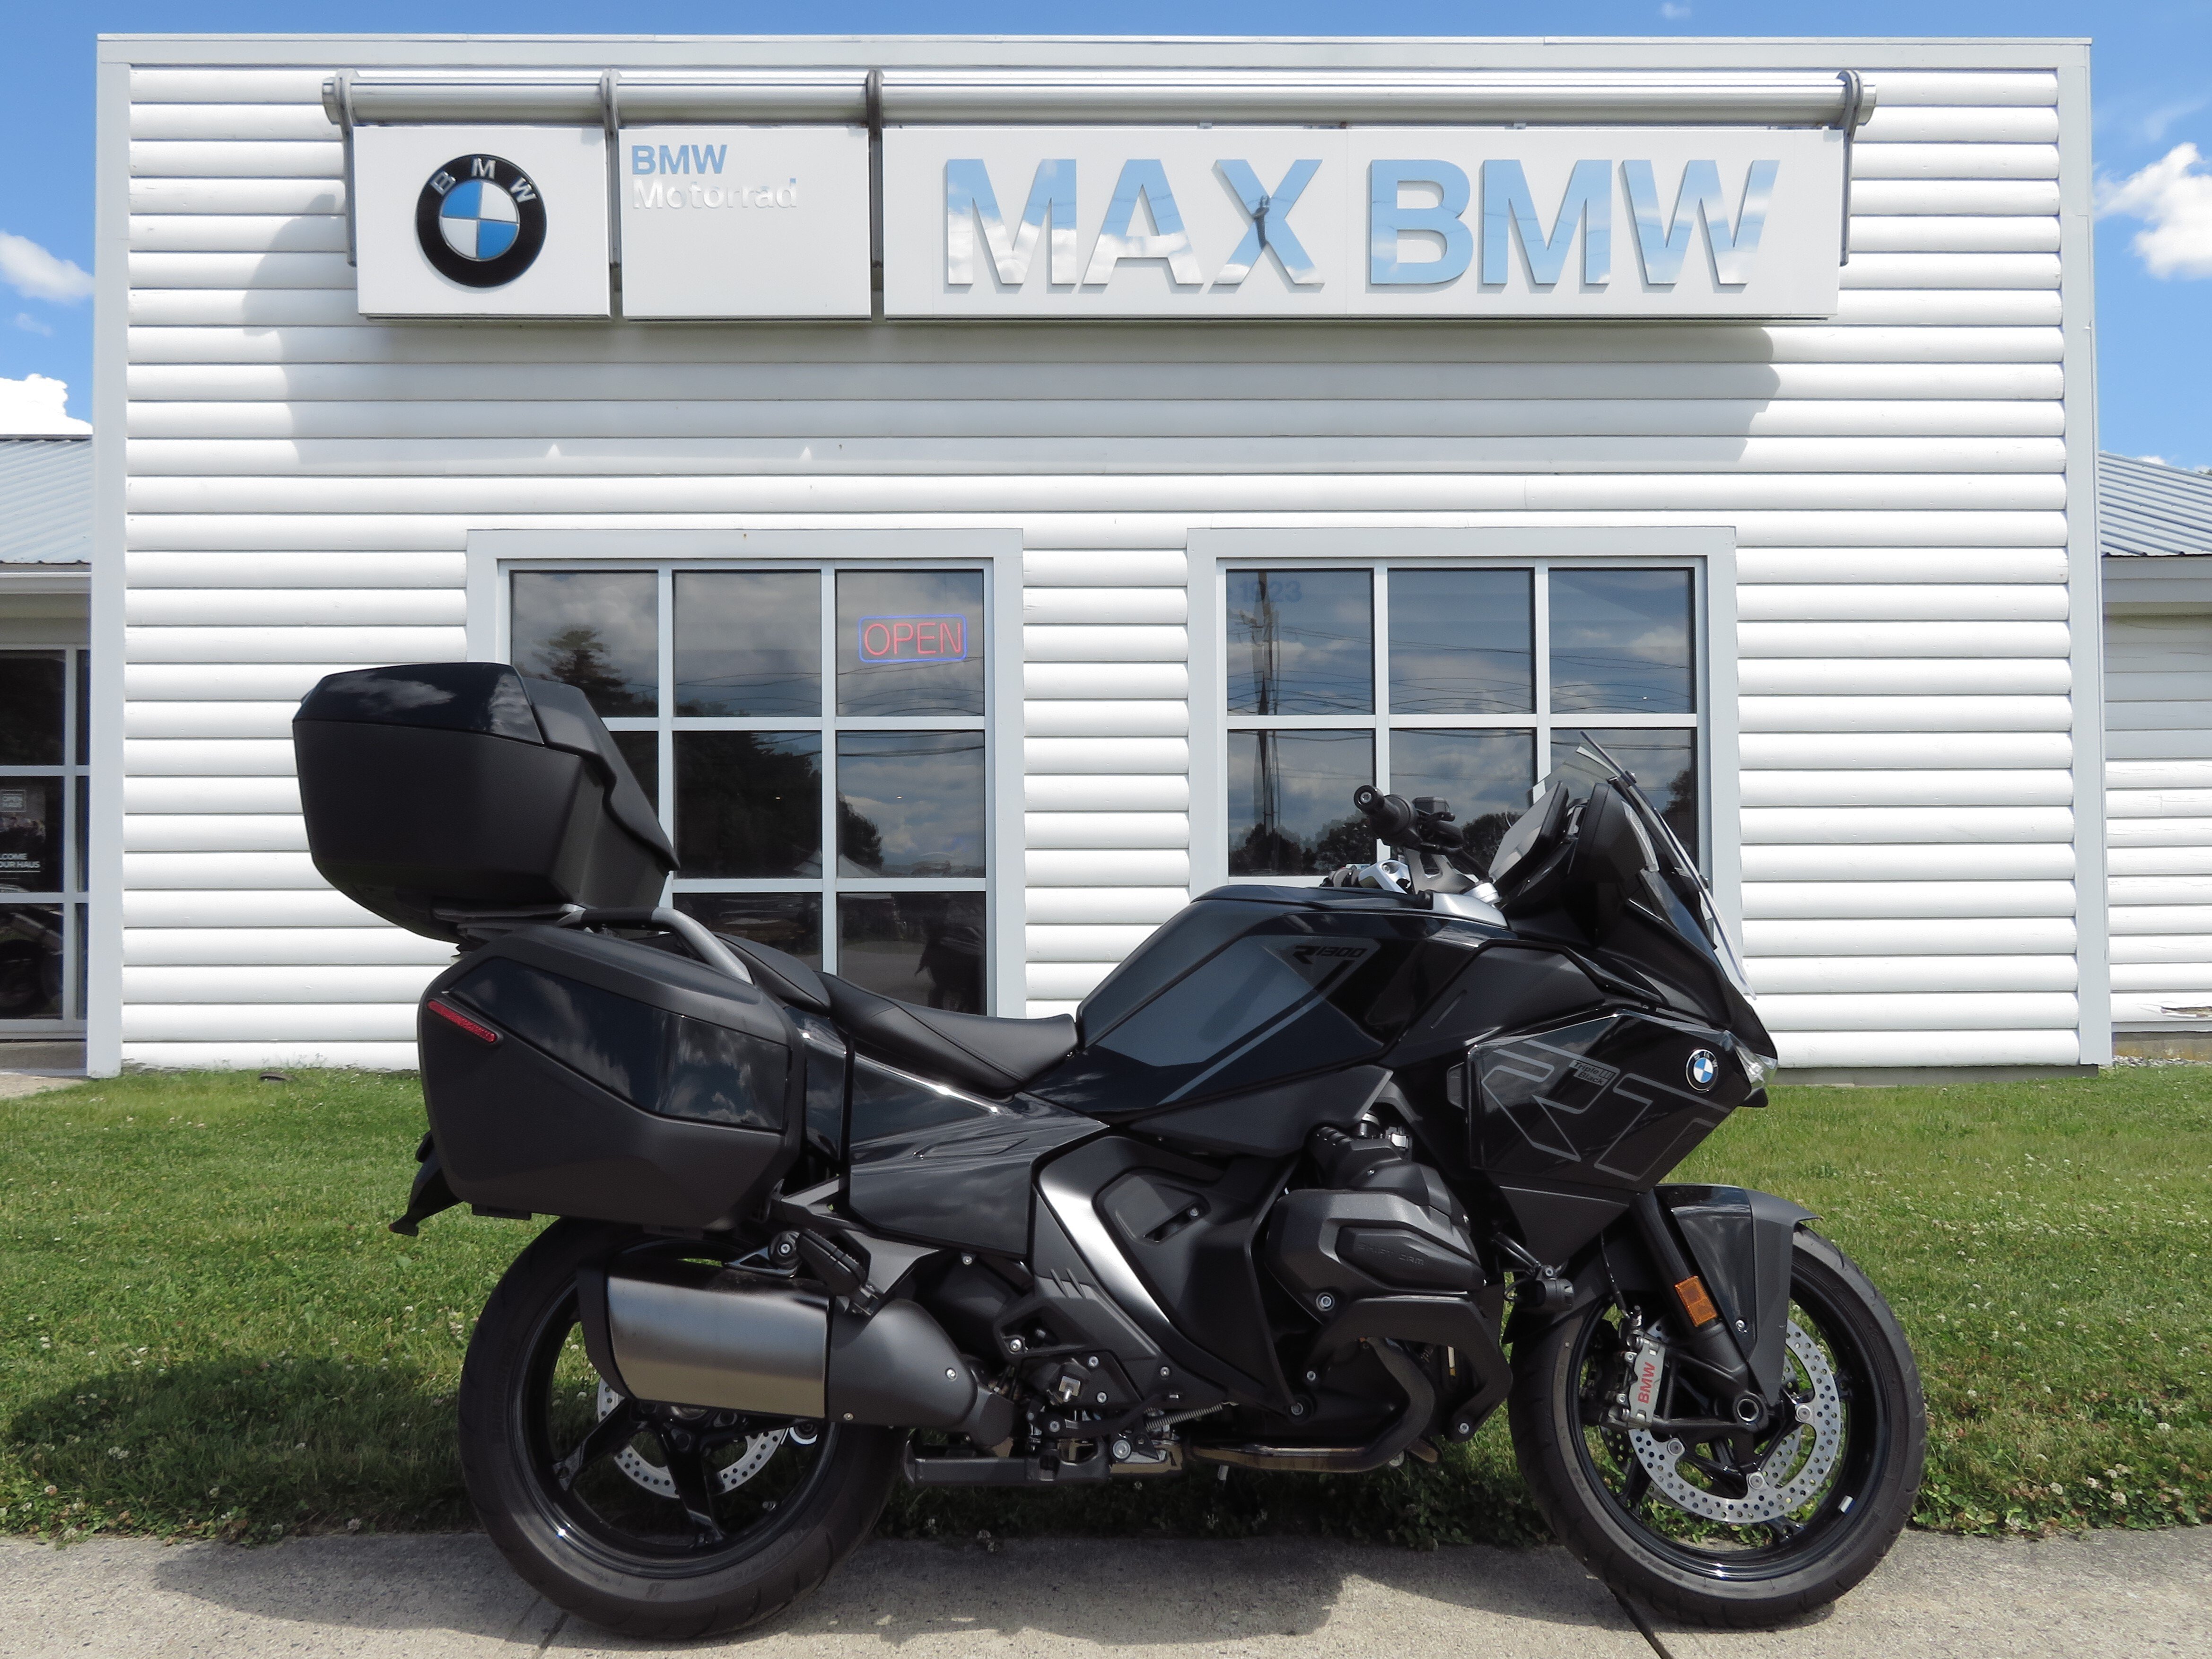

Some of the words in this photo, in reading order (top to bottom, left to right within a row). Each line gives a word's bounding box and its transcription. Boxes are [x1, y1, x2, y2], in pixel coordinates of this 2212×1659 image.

[631, 144, 727, 175] BMW
[429, 157, 537, 205] BMW
[631, 177, 798, 209] Motorrad
[942, 158, 1325, 286] MAX
[1364, 158, 1780, 286] BMW
[864, 622, 961, 656] OPEN
[1574, 1061, 1599, 1074] Triple
[1693, 1051, 1718, 1067] BMW
[1578, 1072, 1604, 1084] Black
[1637, 1362, 1656, 1404] BMW
